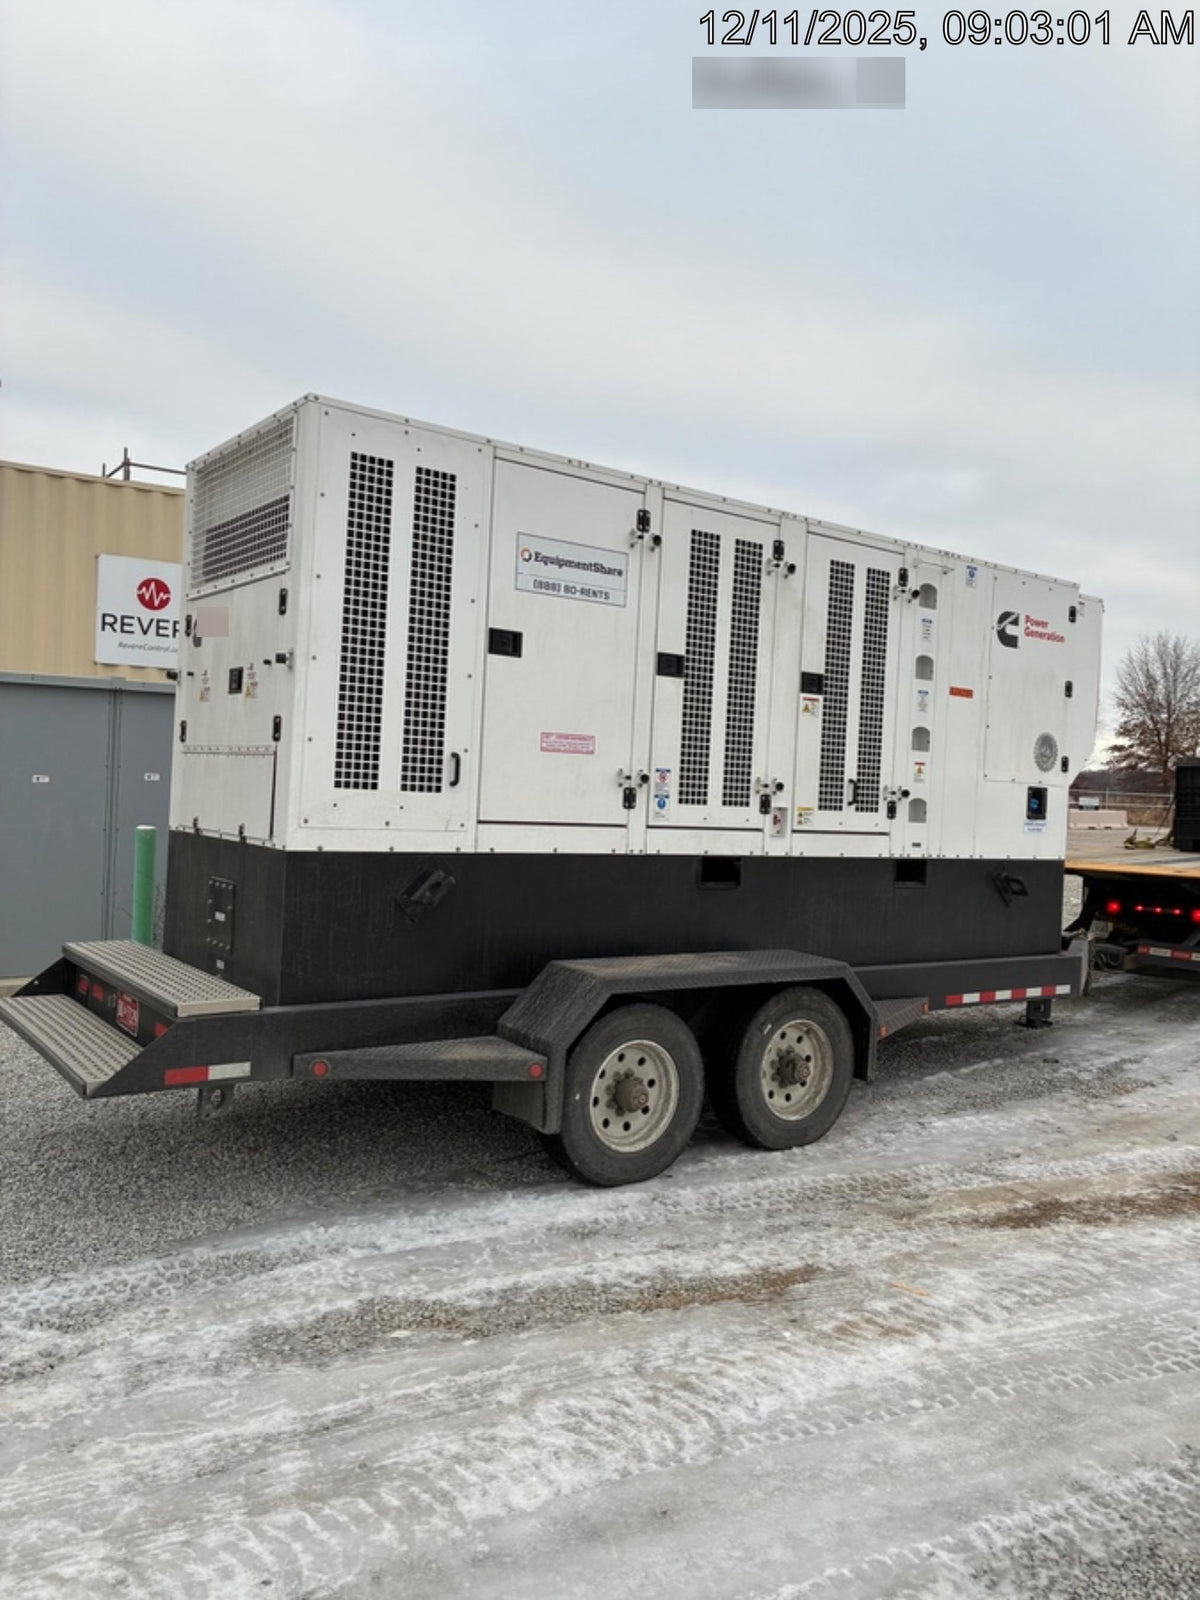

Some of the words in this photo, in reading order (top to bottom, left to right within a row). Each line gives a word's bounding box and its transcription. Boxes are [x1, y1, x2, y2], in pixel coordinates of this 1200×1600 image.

[534, 551, 623, 577] EquipmentShare
[1024, 614, 1049, 628] Power
[1024, 626, 1065, 642] Generation
